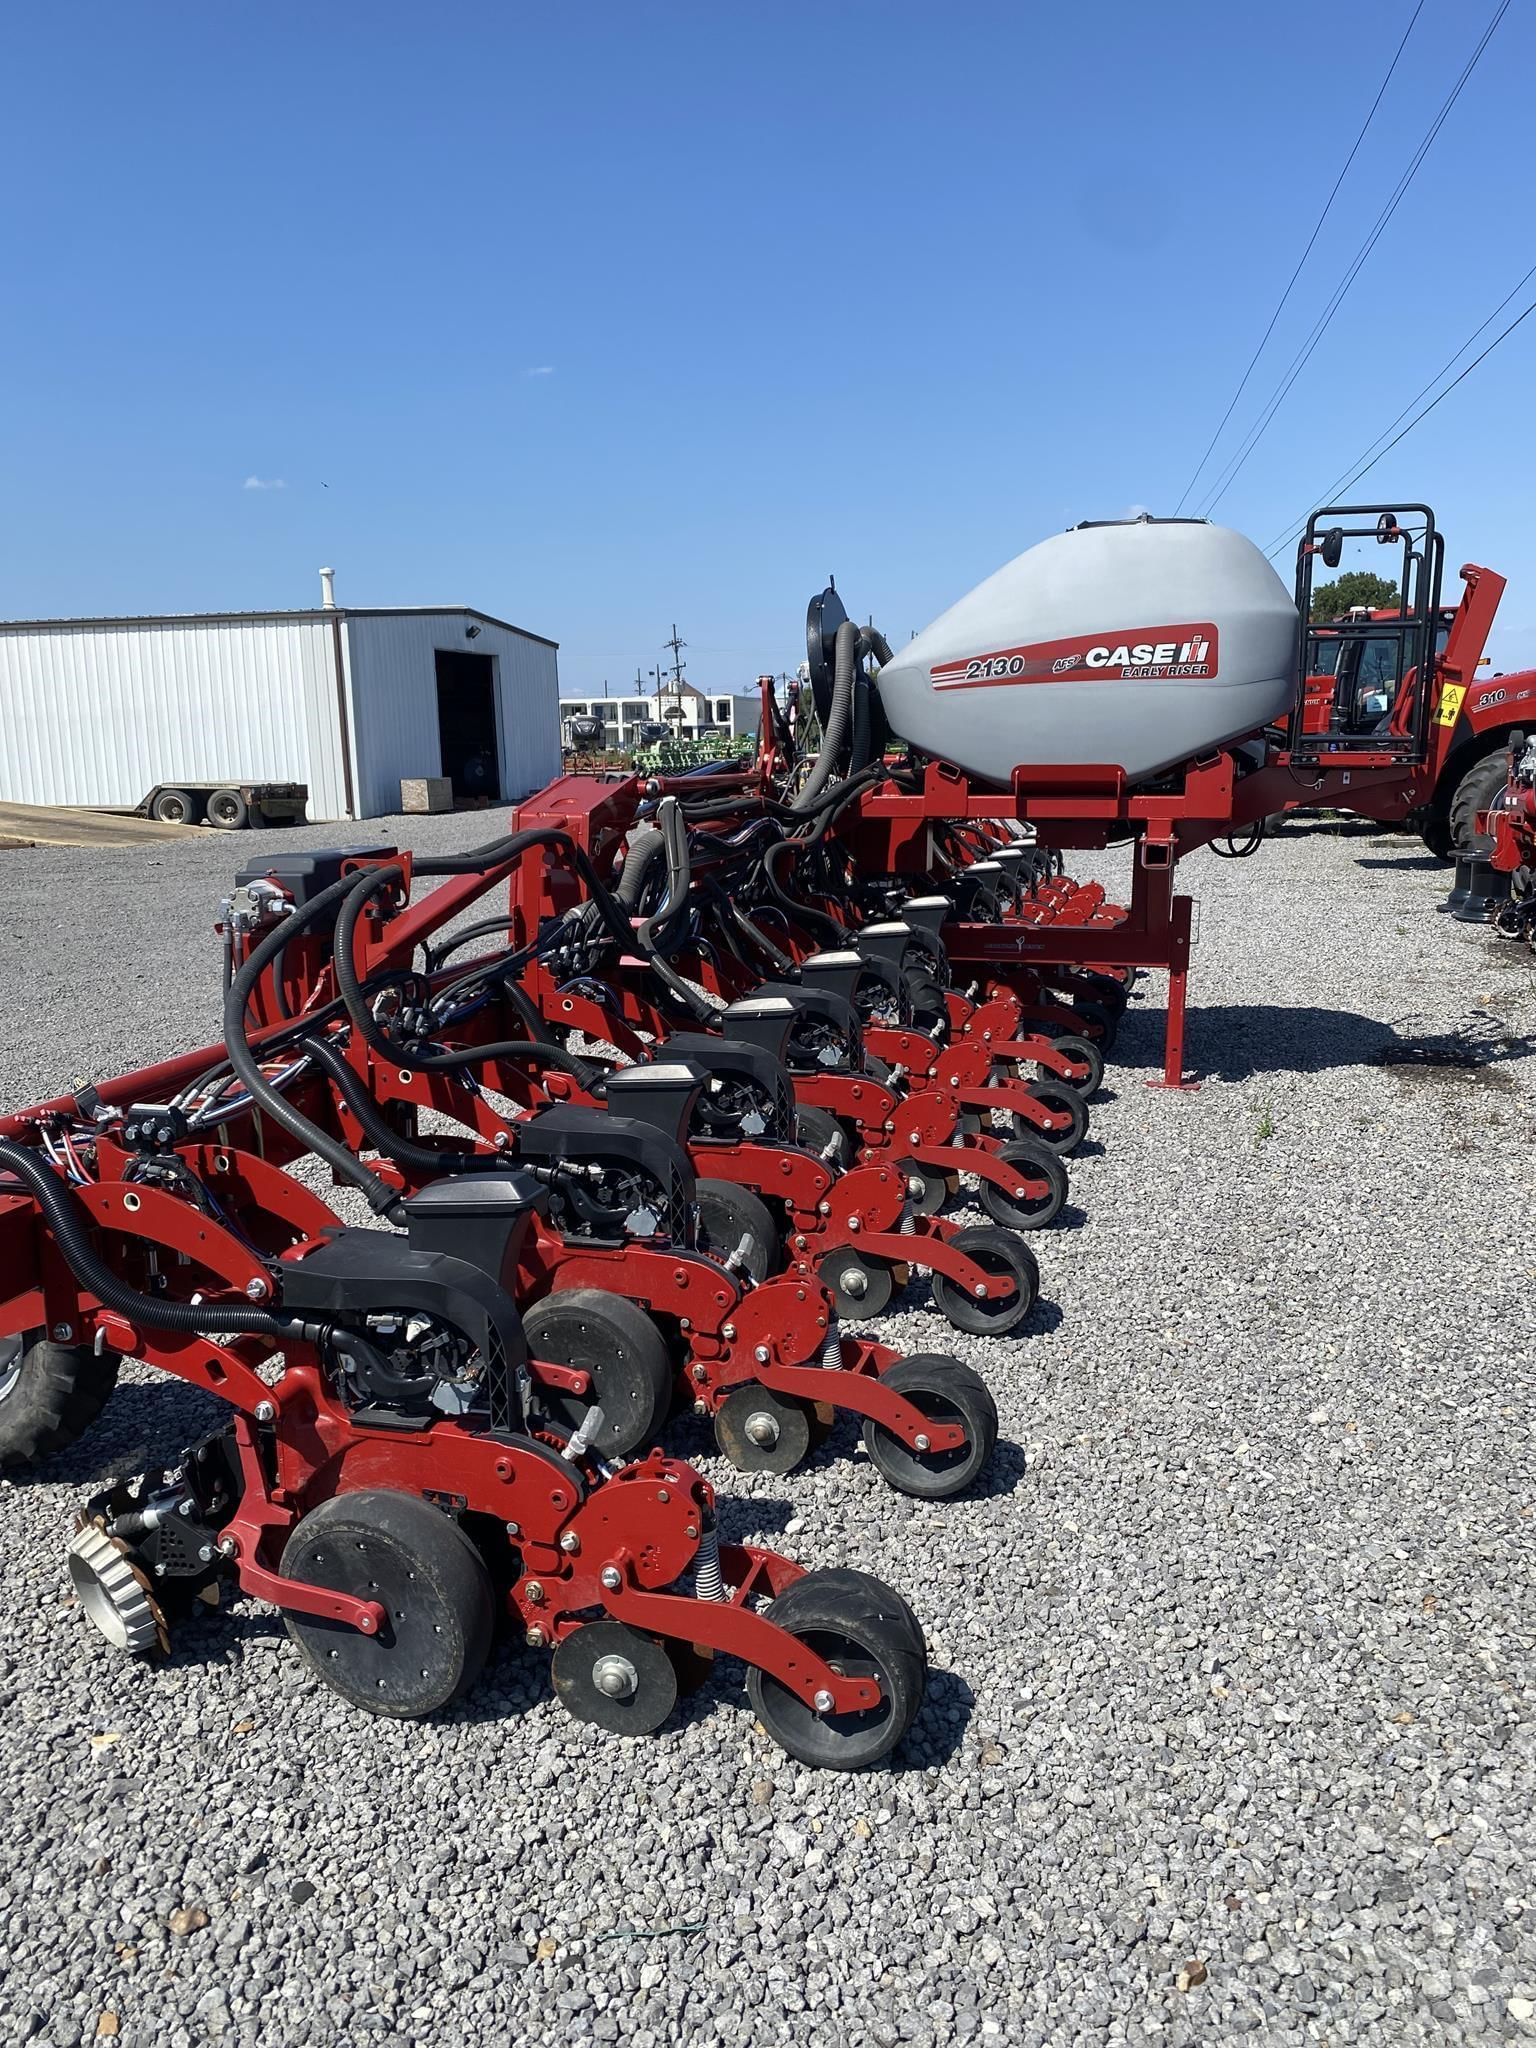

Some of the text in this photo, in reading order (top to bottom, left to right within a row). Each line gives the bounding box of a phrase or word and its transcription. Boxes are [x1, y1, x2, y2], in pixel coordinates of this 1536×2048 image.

[965, 655, 1025, 680] 2130
[1053, 656, 1080, 673] AFS
[1085, 643, 1177, 668] CASE
[1121, 664, 1209, 678] EARLY RISER
[1479, 688, 1507, 706] 310
